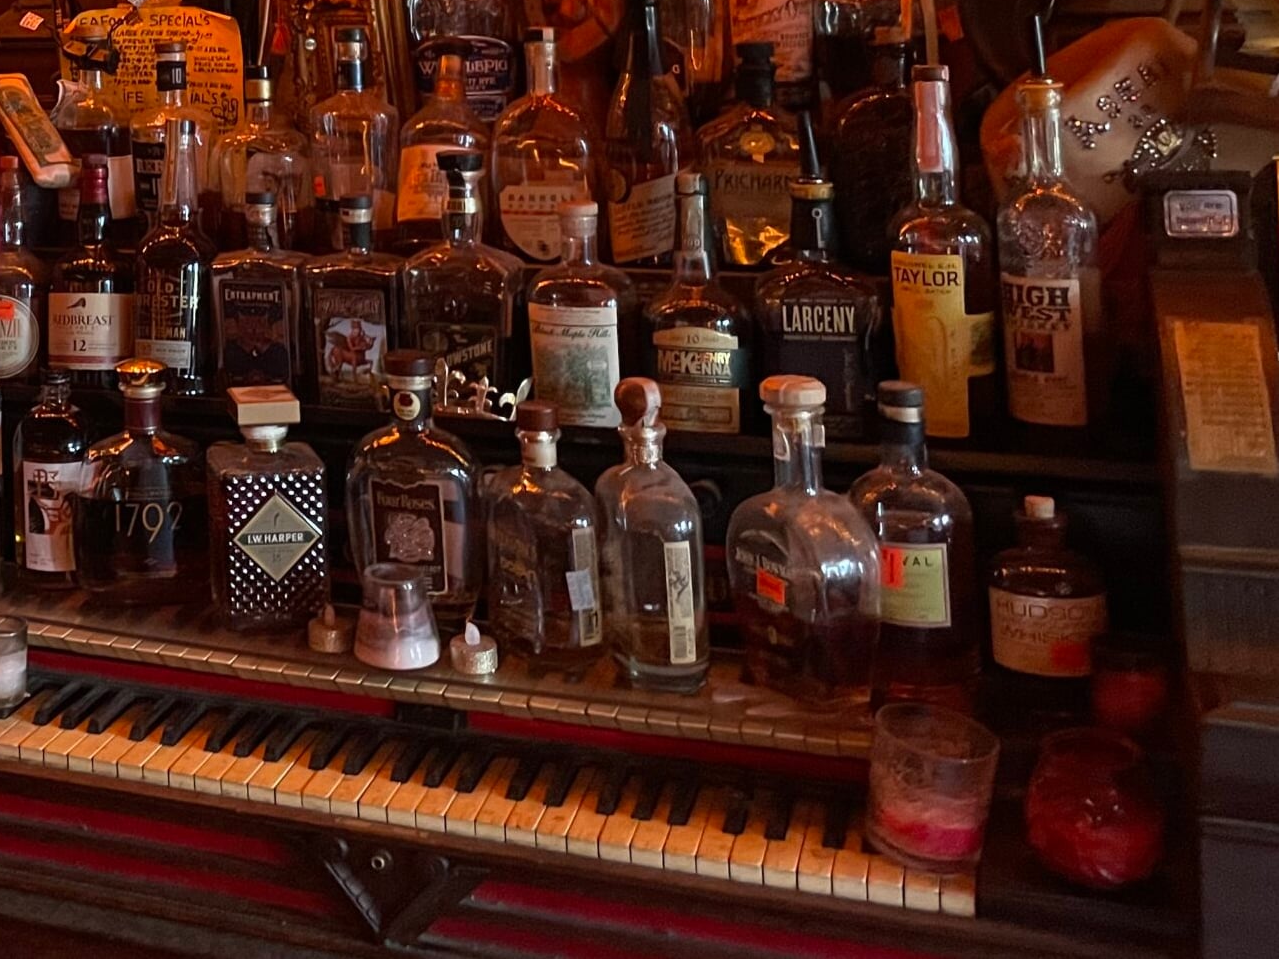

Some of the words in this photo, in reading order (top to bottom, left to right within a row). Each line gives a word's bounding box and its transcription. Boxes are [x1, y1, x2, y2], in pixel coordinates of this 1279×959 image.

[149, 13, 211, 28] SPECIAL'S
[895, 266, 960, 287] TAYLOR
[146, 280, 175, 295] OLD
[782, 303, 856, 334] LARCENY
[71, 339, 88, 353] 12
[405, 492, 436, 511] Roses
[112, 499, 184, 545] 1792
[264, 532, 305, 544] HARPER
[901, 554, 933, 568] VAL
